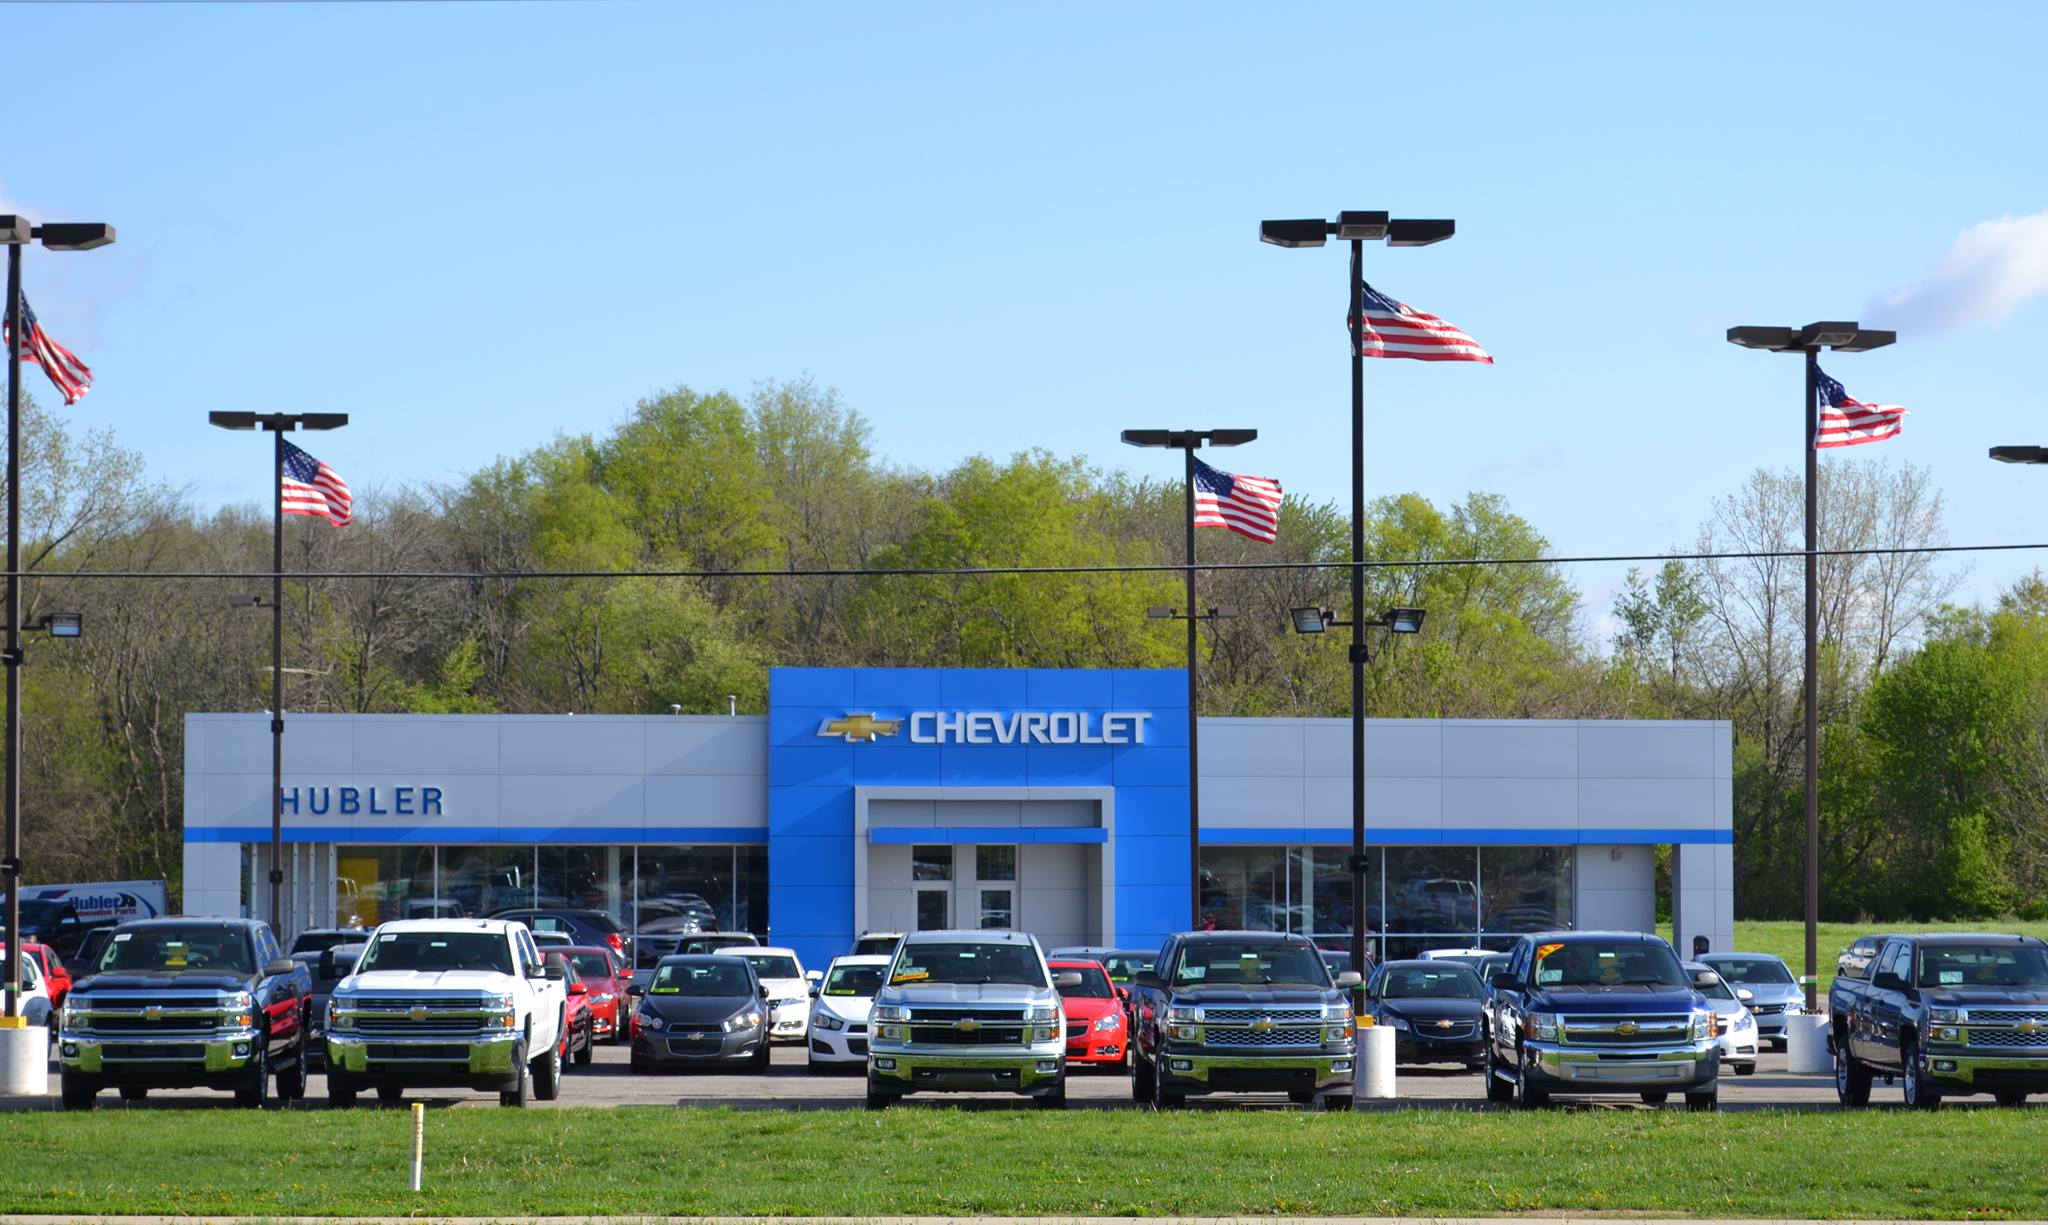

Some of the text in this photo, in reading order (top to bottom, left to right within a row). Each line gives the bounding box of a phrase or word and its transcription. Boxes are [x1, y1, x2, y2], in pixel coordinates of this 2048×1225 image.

[910, 711, 1152, 744] CHEVROLET
[279, 786, 444, 816] HUBLER
[69, 895, 121, 910] Hubler
